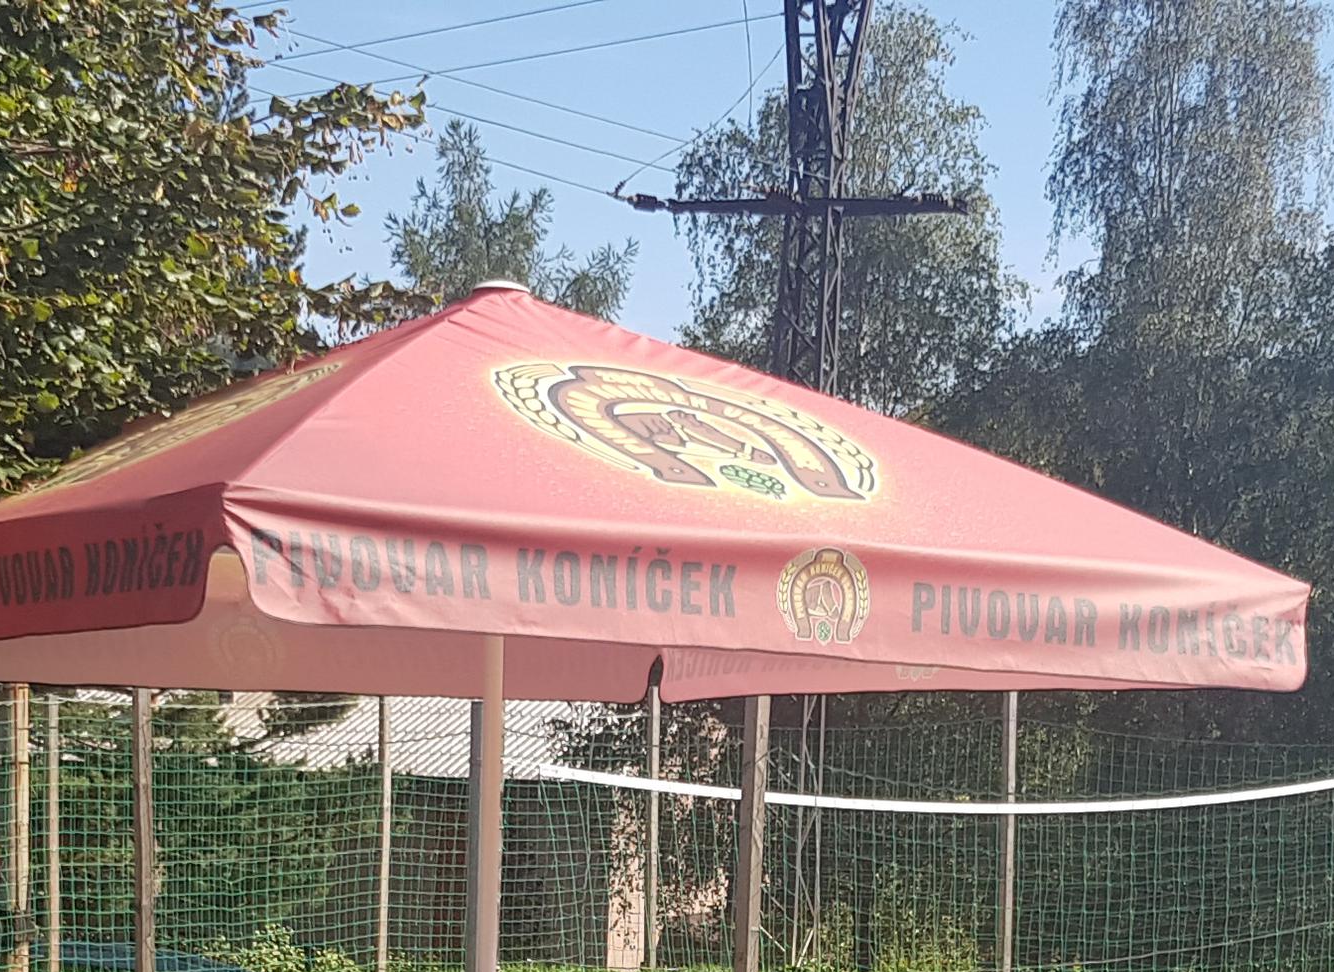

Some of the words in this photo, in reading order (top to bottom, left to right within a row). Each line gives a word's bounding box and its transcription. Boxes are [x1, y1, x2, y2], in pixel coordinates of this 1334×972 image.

[84, 522, 205, 596] KONÍČEK
[251, 526, 492, 601] PIVOVAR
[515, 546, 738, 618] KONÍČEK
[911, 581, 1099, 648] PIVOVAR
[1117, 601, 1298, 666] KONÍČEK
